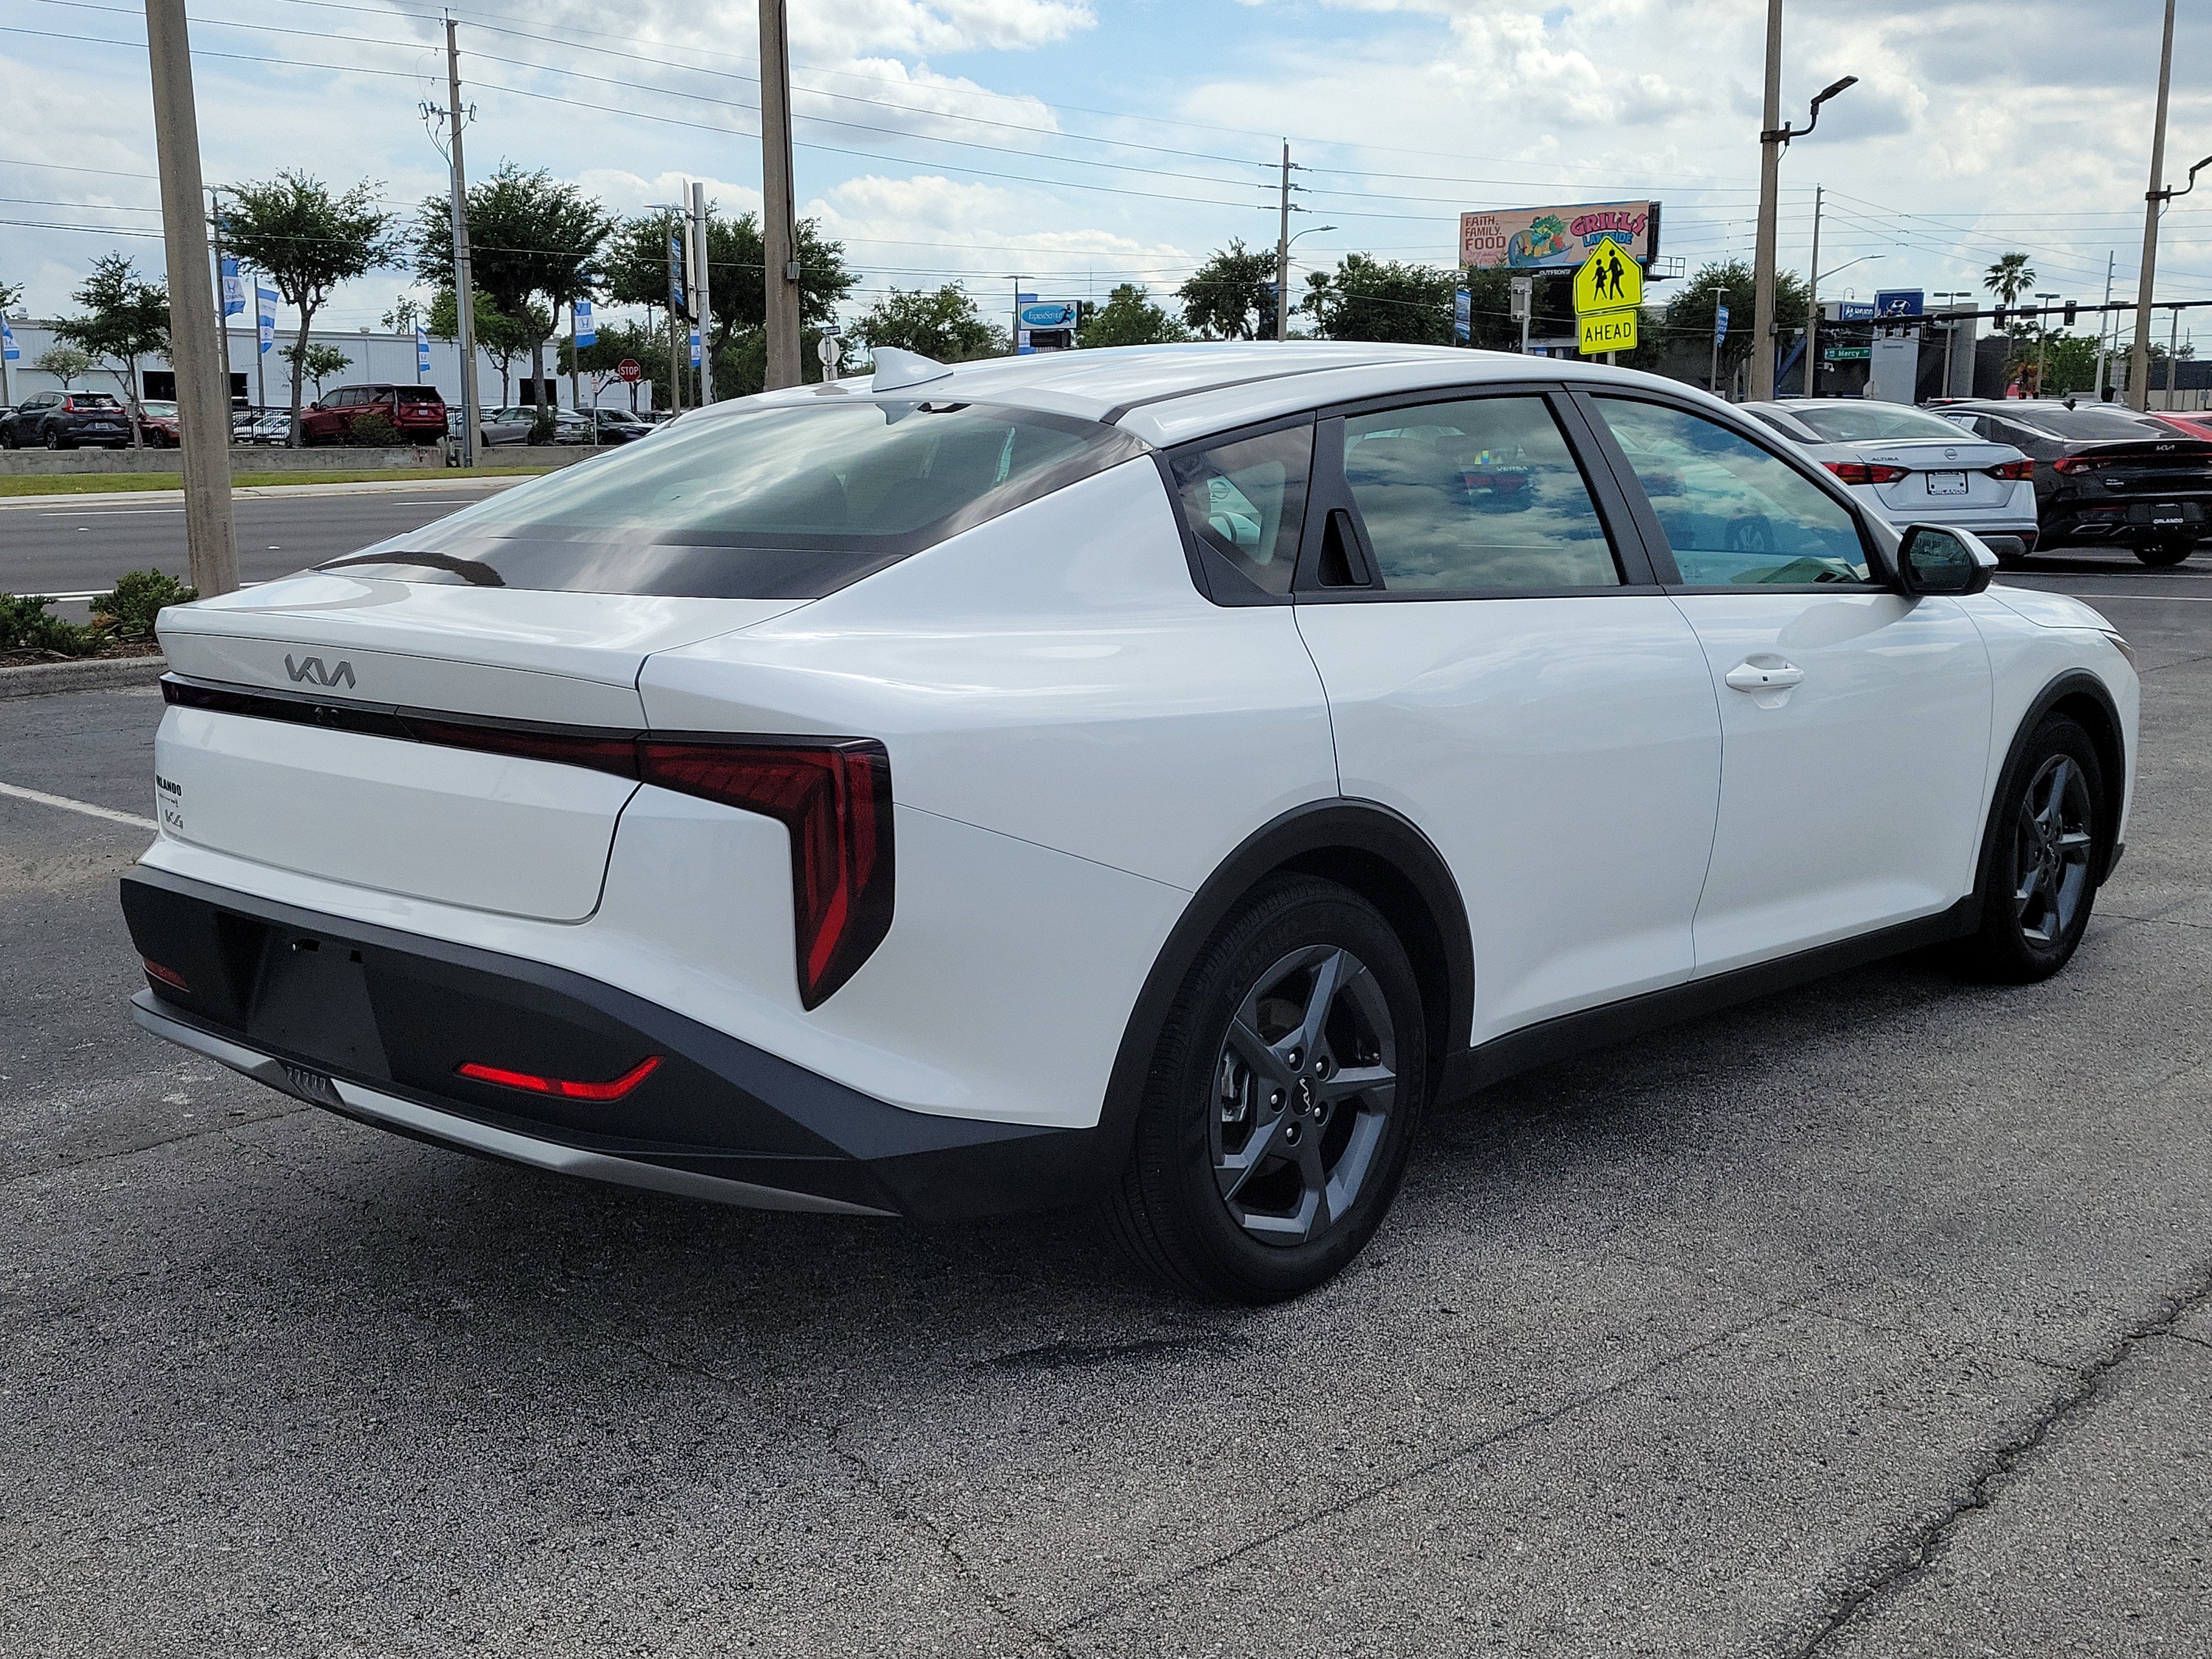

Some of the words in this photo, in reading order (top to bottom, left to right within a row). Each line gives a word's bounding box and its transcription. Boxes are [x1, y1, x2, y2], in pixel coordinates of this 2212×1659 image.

[1465, 215, 1499, 227] FAITH.
[1571, 212, 1647, 236] GRILLS
[1465, 226, 1502, 237] FAMILY.
[1465, 236, 1506, 251] FOOD
[1582, 232, 1633, 247] LAKSIDE
[1585, 322, 1631, 342] AHEAD
[620, 366, 639, 375] STOP
[284, 653, 356, 689] KIA
[165, 809, 183, 830] K4
